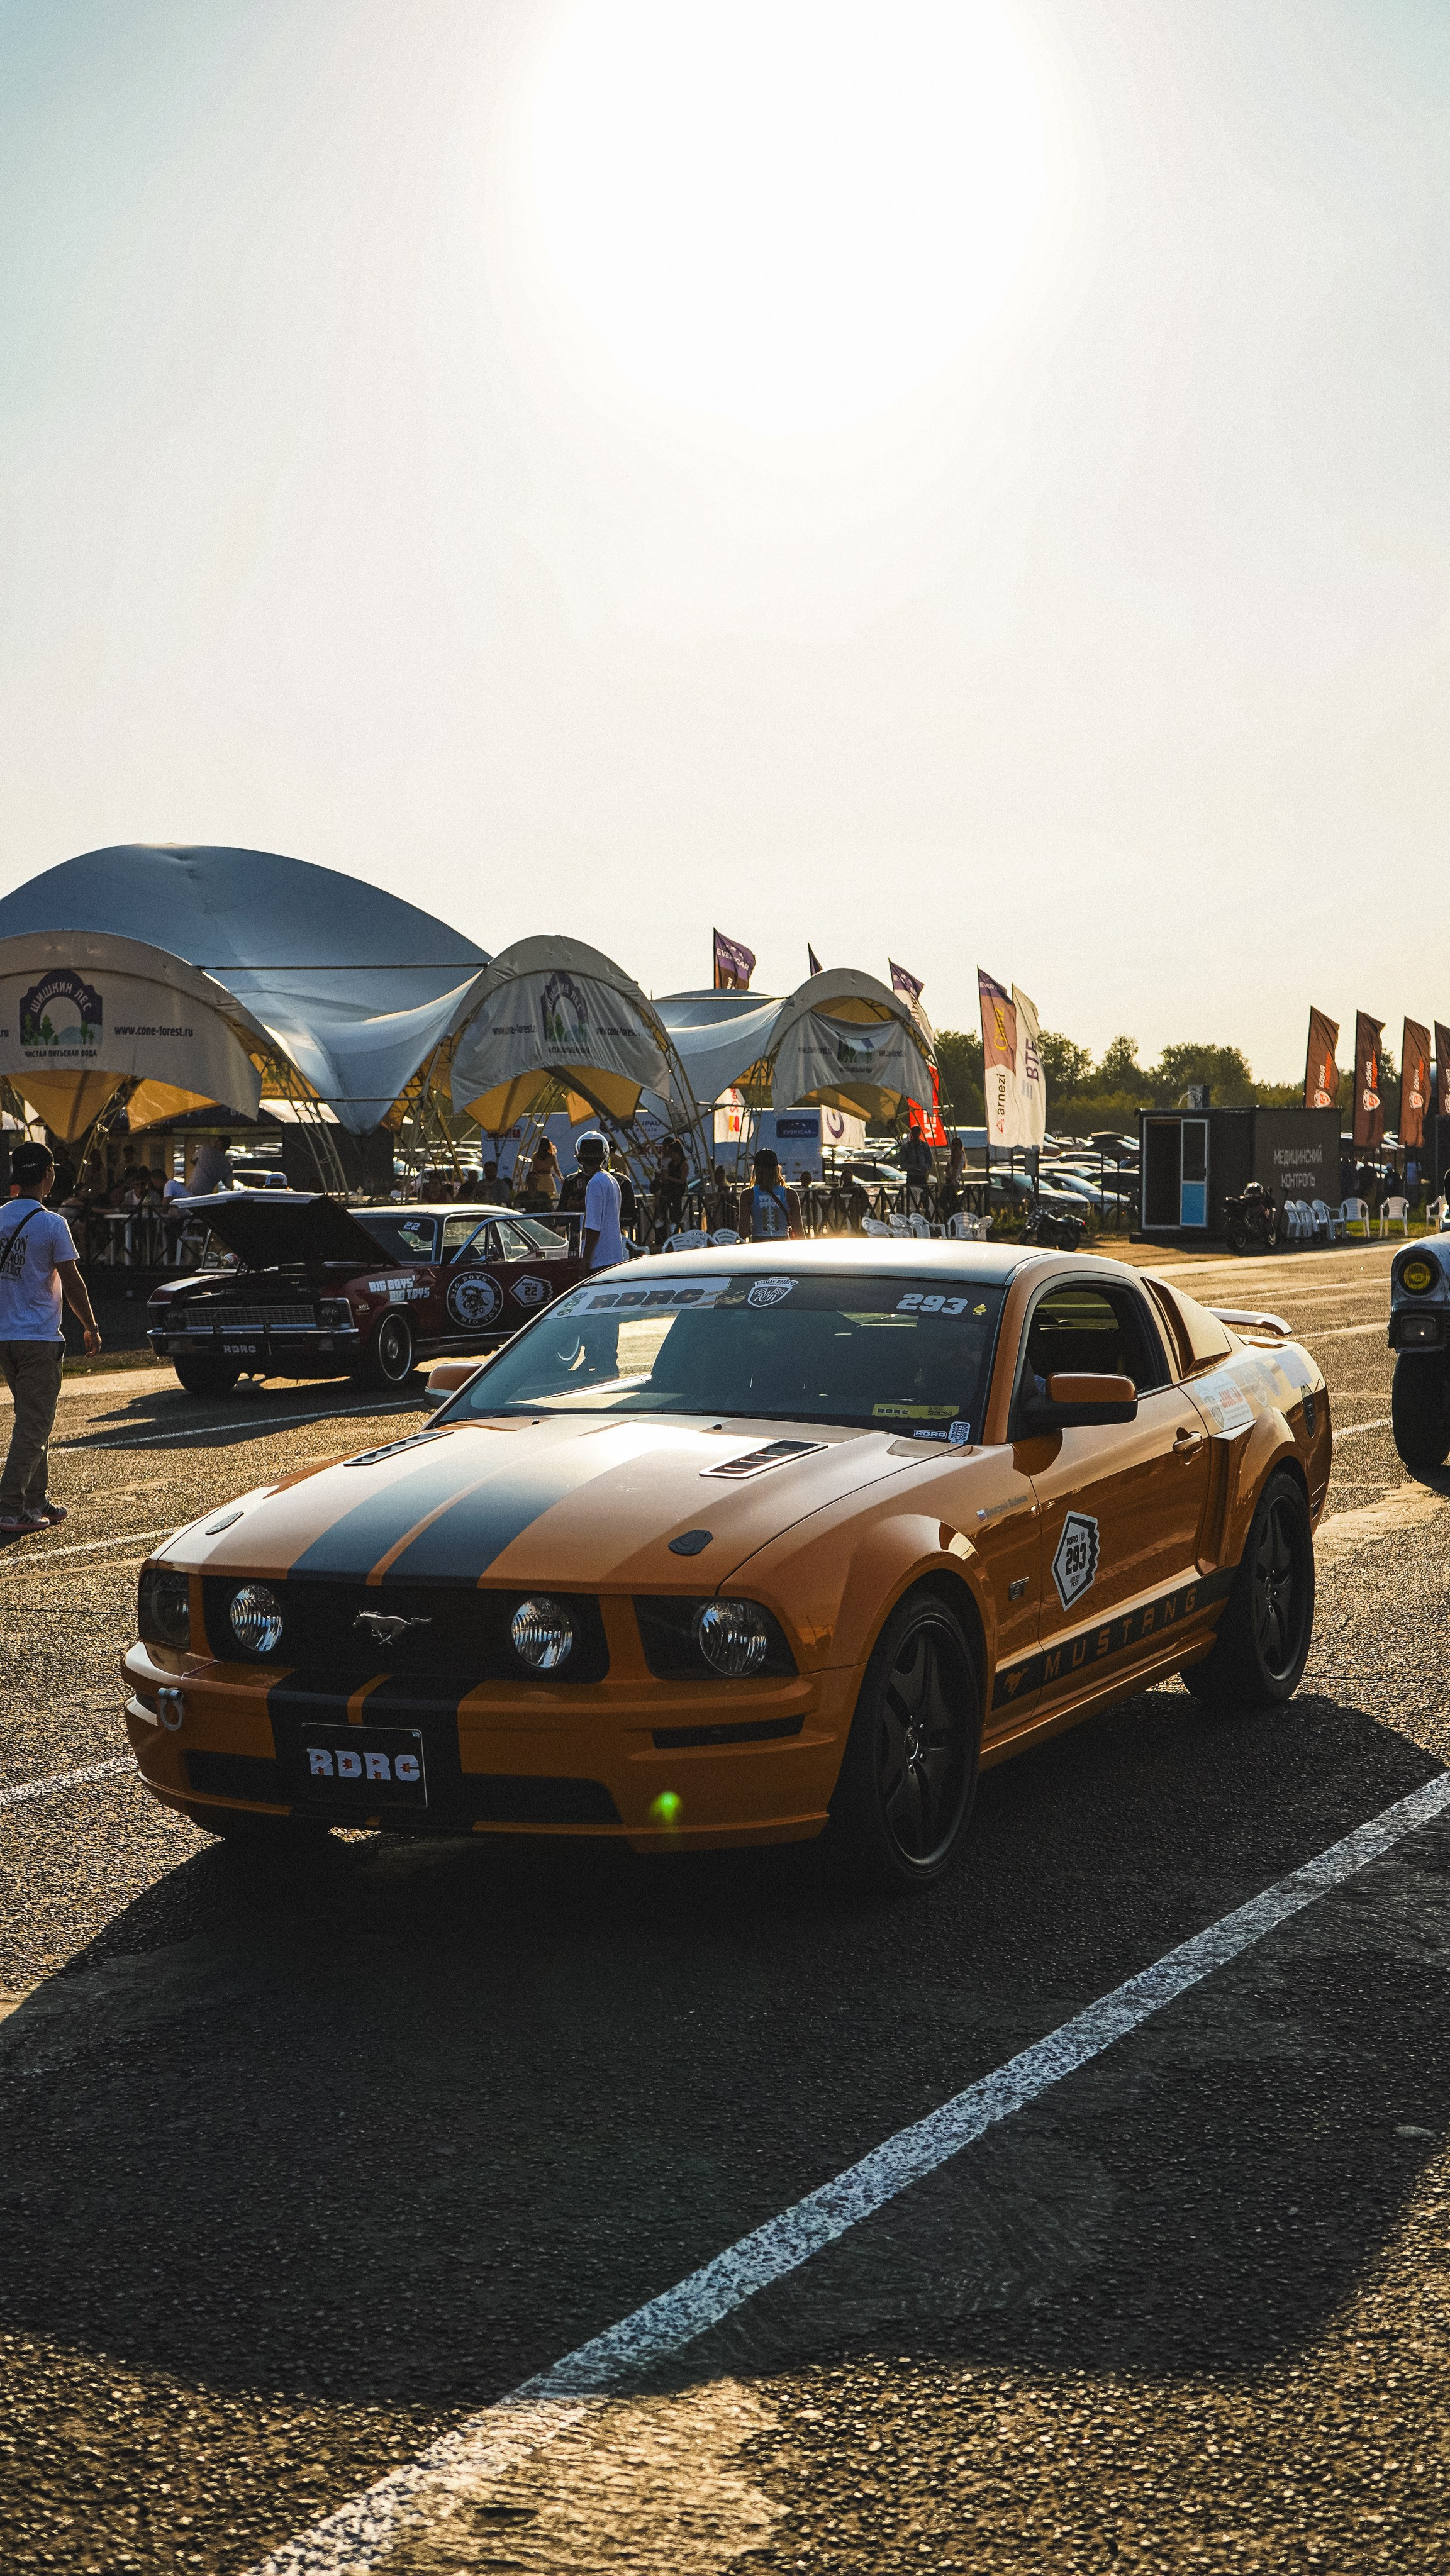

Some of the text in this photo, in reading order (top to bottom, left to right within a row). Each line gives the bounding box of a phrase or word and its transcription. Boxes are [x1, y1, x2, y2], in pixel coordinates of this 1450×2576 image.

[30, 982, 92, 1013] ШИШКИН ЛЕС
[114, 1026, 194, 1038] www.cone-forest.ru
[997, 1073, 1006, 1115] arnezi
[1274, 1143, 1322, 1167] МЕДИЦИНСКИЙ
[1281, 1172, 1315, 1189] КОНТРОЛЬ
[403, 1221, 421, 1231] 22
[369, 1275, 416, 1292] BIG BOYS'
[450, 1283, 460, 1299] BIG
[525, 1286, 537, 1296] 22
[389, 1287, 430, 1302] BIG TOYS
[585, 1288, 706, 1310] RDRC
[896, 1293, 968, 1314] 293
[223, 1345, 257, 1353] RDRC
[1067, 1535, 1078, 1546] RDRC
[1065, 1542, 1086, 1576] 293
[1044, 1588, 1197, 1681] MUSTANG
[306, 1748, 420, 1782] RDRC
